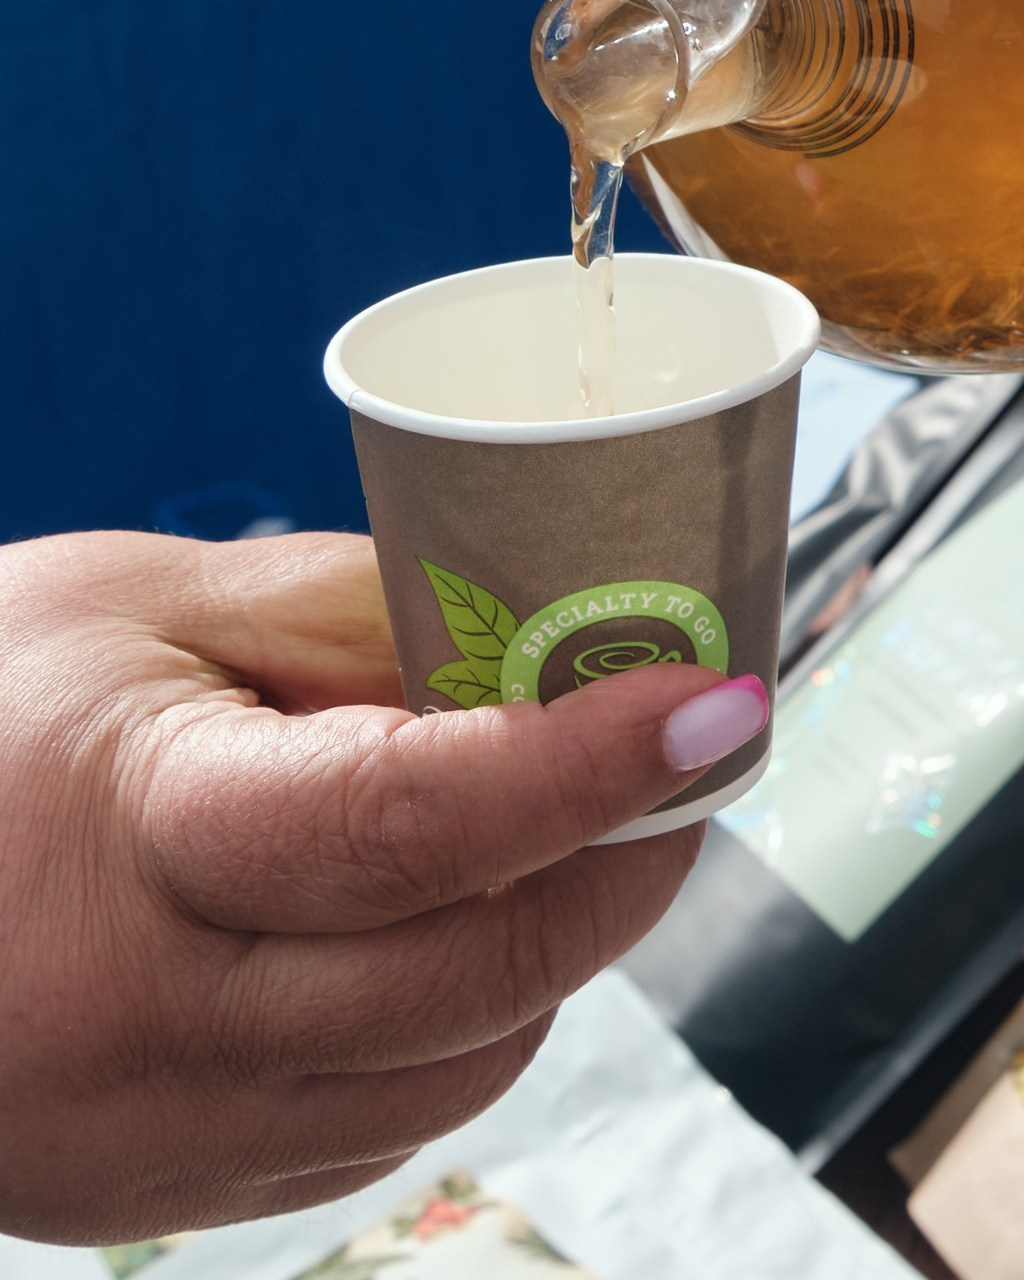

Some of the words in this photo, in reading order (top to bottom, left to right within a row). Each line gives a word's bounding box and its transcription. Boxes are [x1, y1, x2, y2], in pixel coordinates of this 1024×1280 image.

[522, 592, 657, 659] SPECIALTY
[664, 595, 694, 619] TO
[693, 616, 717, 645] GO
